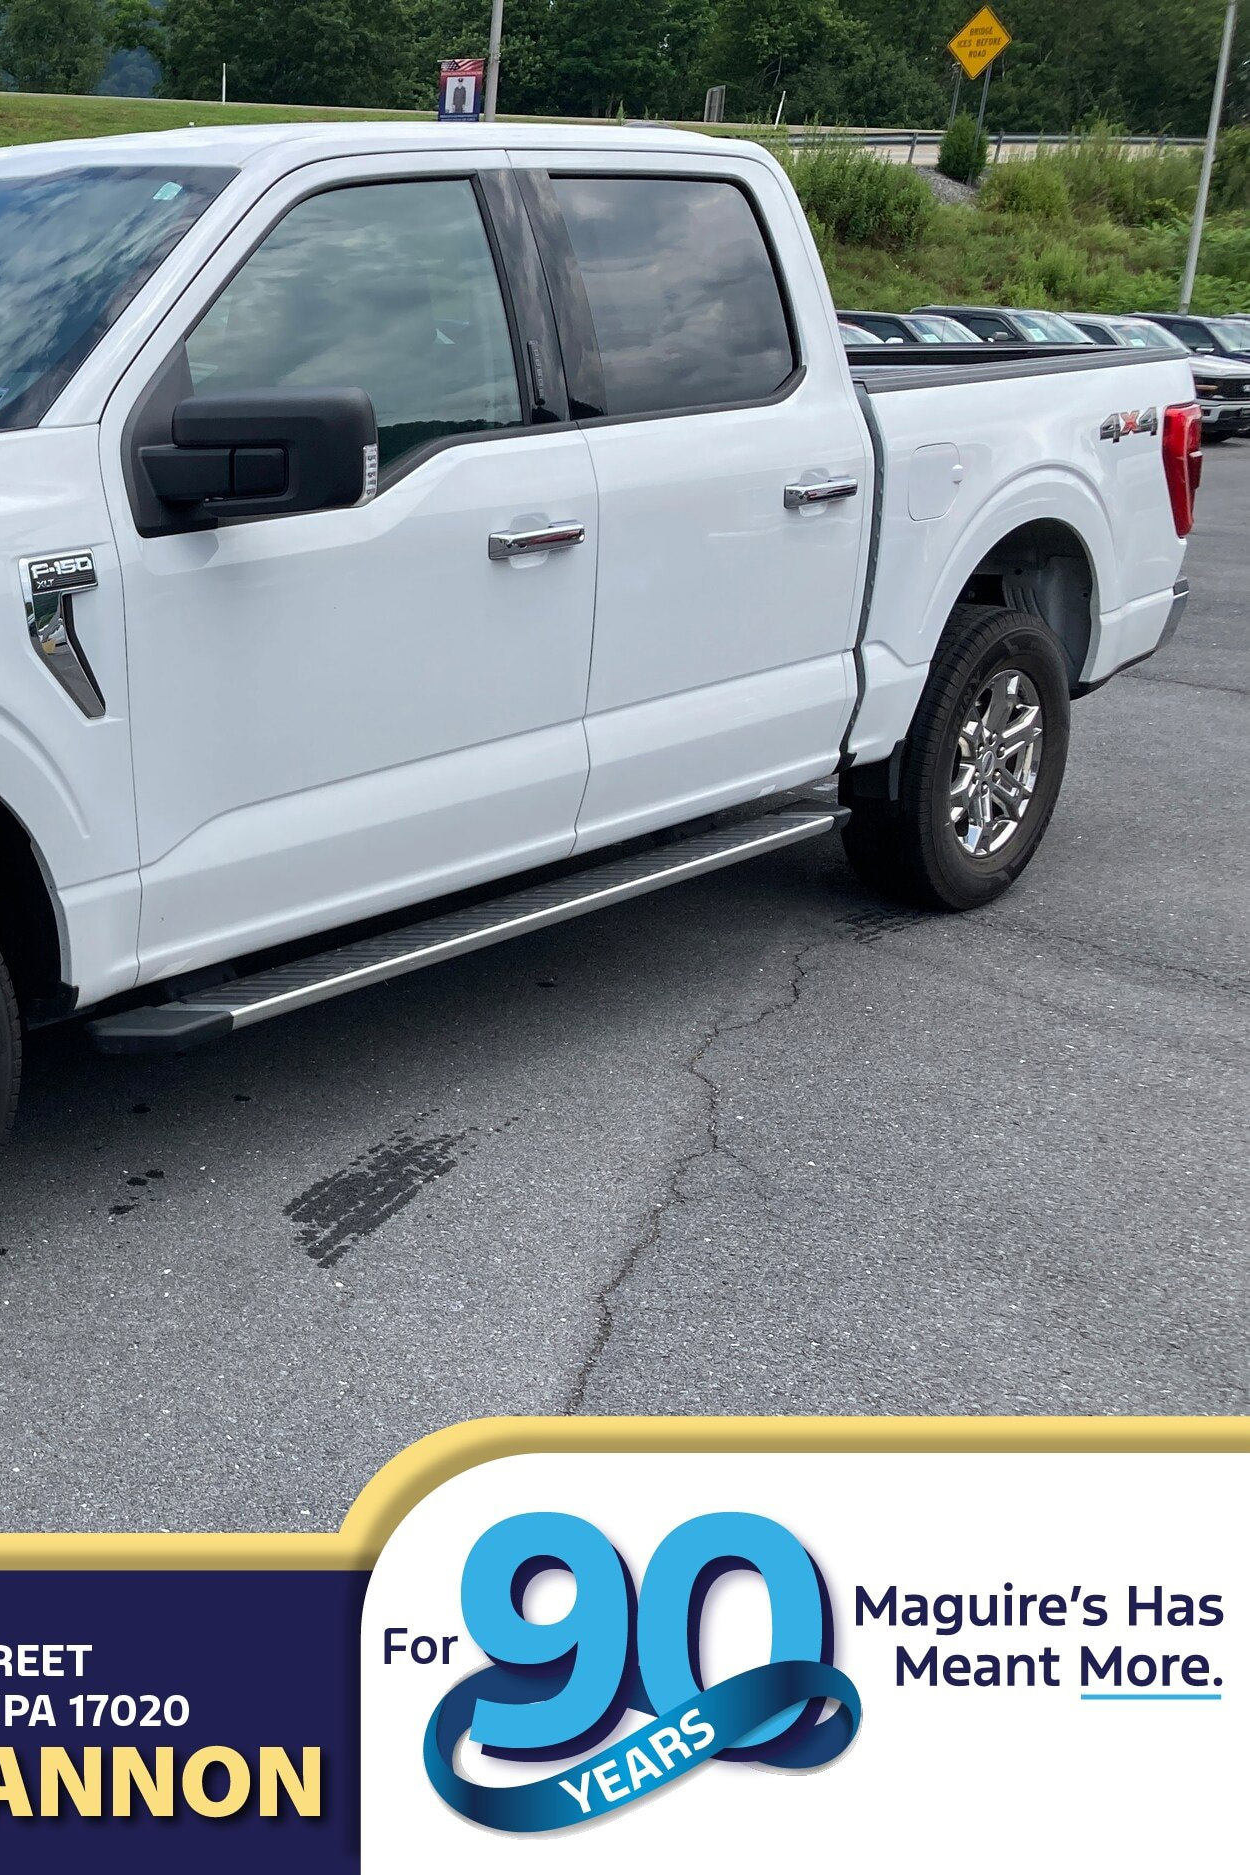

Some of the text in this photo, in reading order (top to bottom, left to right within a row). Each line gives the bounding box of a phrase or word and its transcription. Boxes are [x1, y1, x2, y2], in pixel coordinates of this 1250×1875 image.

[969, 27, 994, 36] BRIDGE
[957, 37, 1002, 48] ICES BEFORE
[968, 50, 987, 58] ROAD
[30, 556, 93, 579] F-150
[36, 579, 54, 590] XLT
